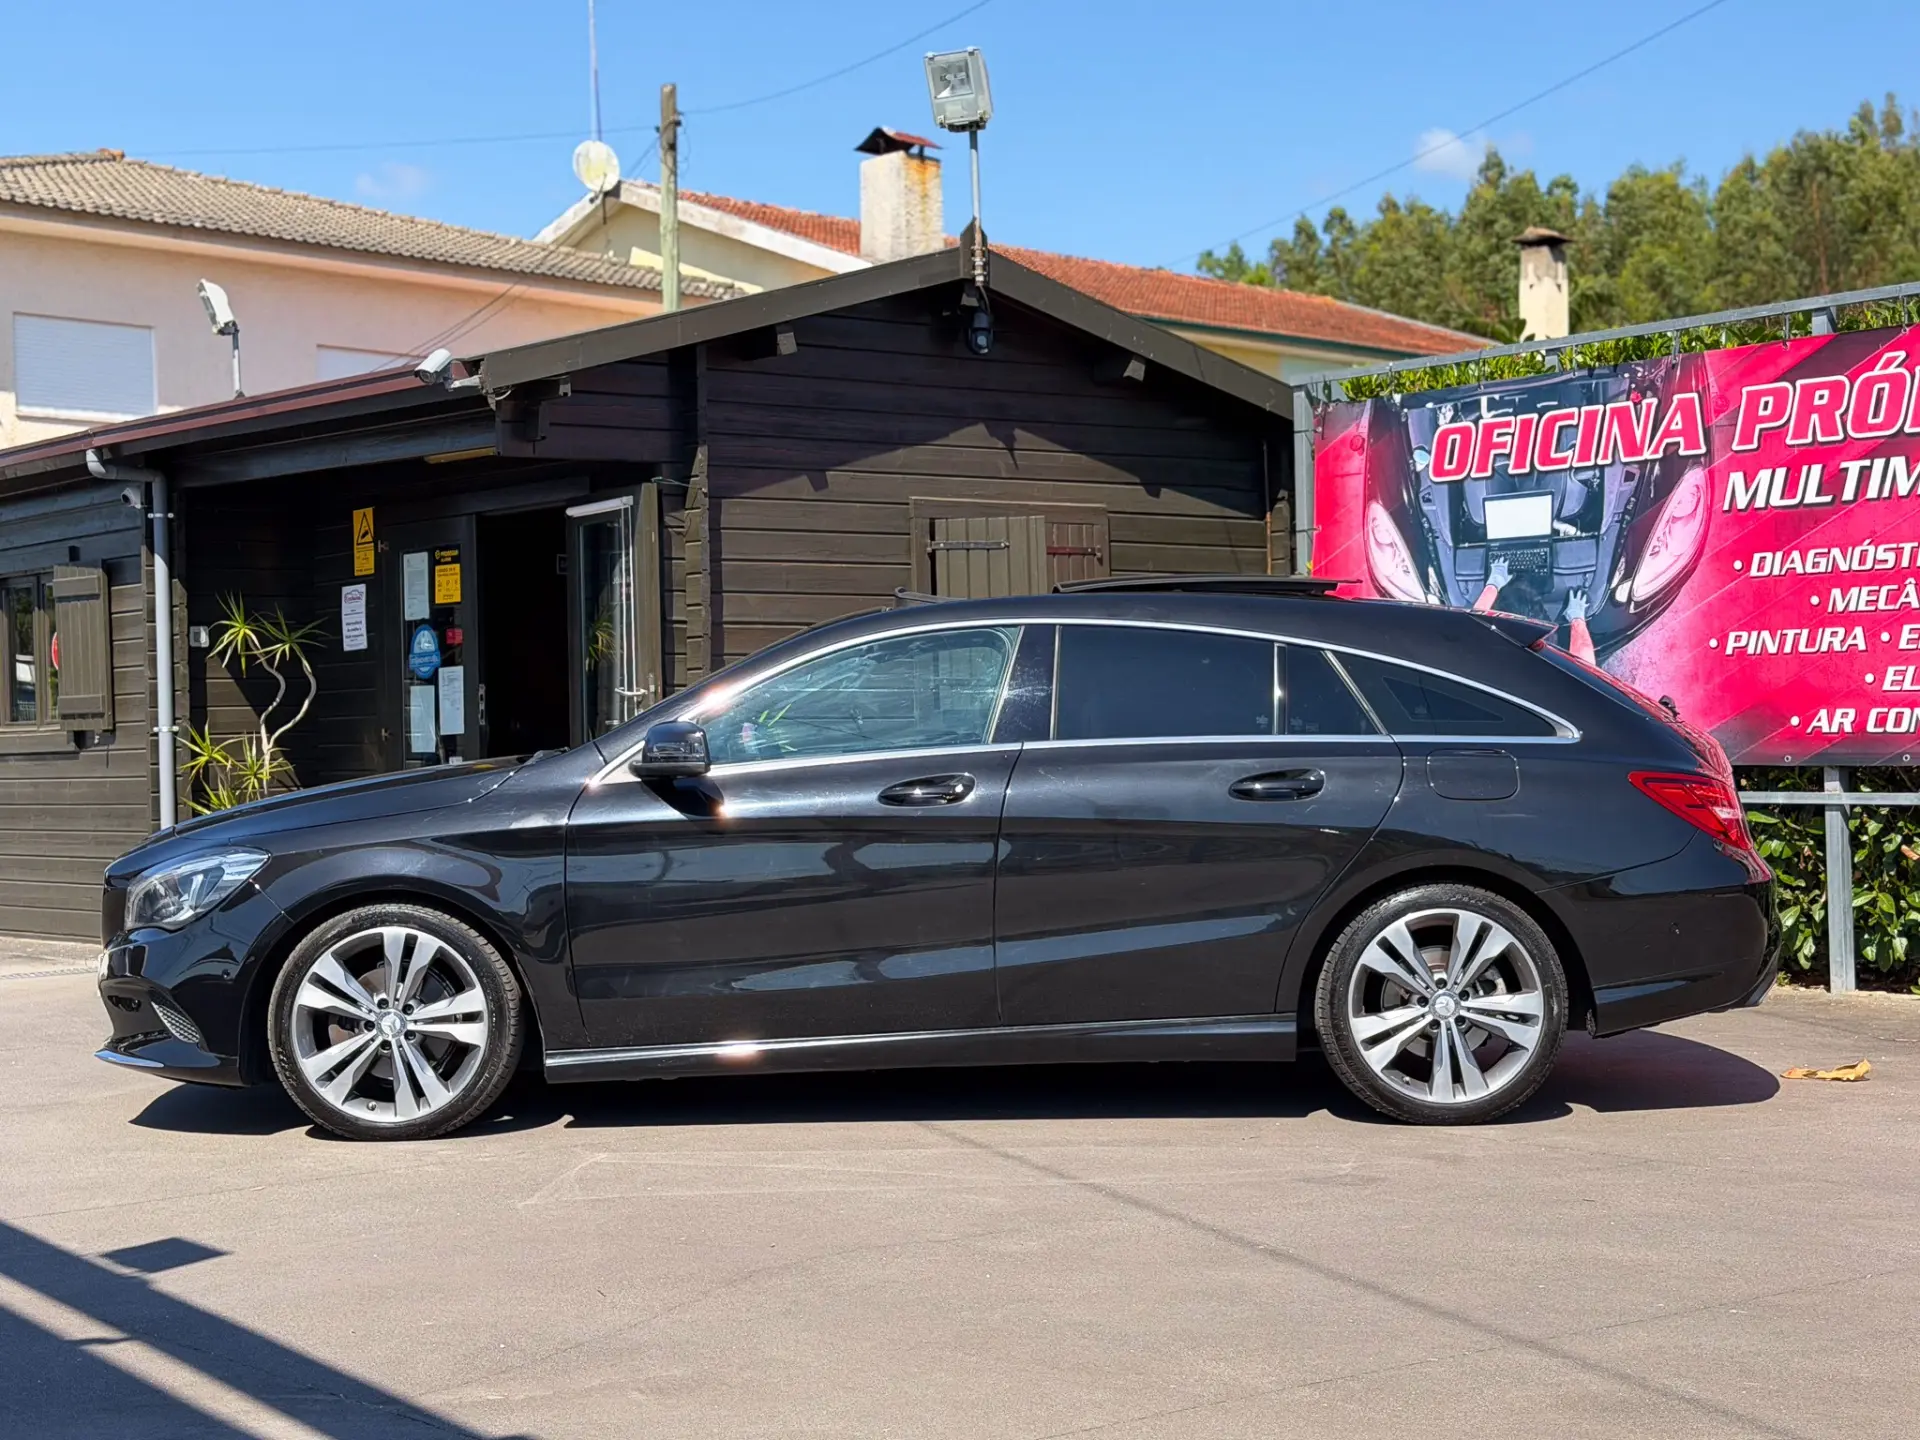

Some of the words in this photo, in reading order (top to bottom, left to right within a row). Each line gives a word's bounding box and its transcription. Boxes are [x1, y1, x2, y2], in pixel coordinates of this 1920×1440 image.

[1429, 392, 1706, 482] OFICINA
[1722, 455, 1920, 511] MULTIM
[1827, 577, 1920, 613] MECÂ
[1725, 626, 1868, 655] PINTURA
[1806, 708, 1857, 733] AR
